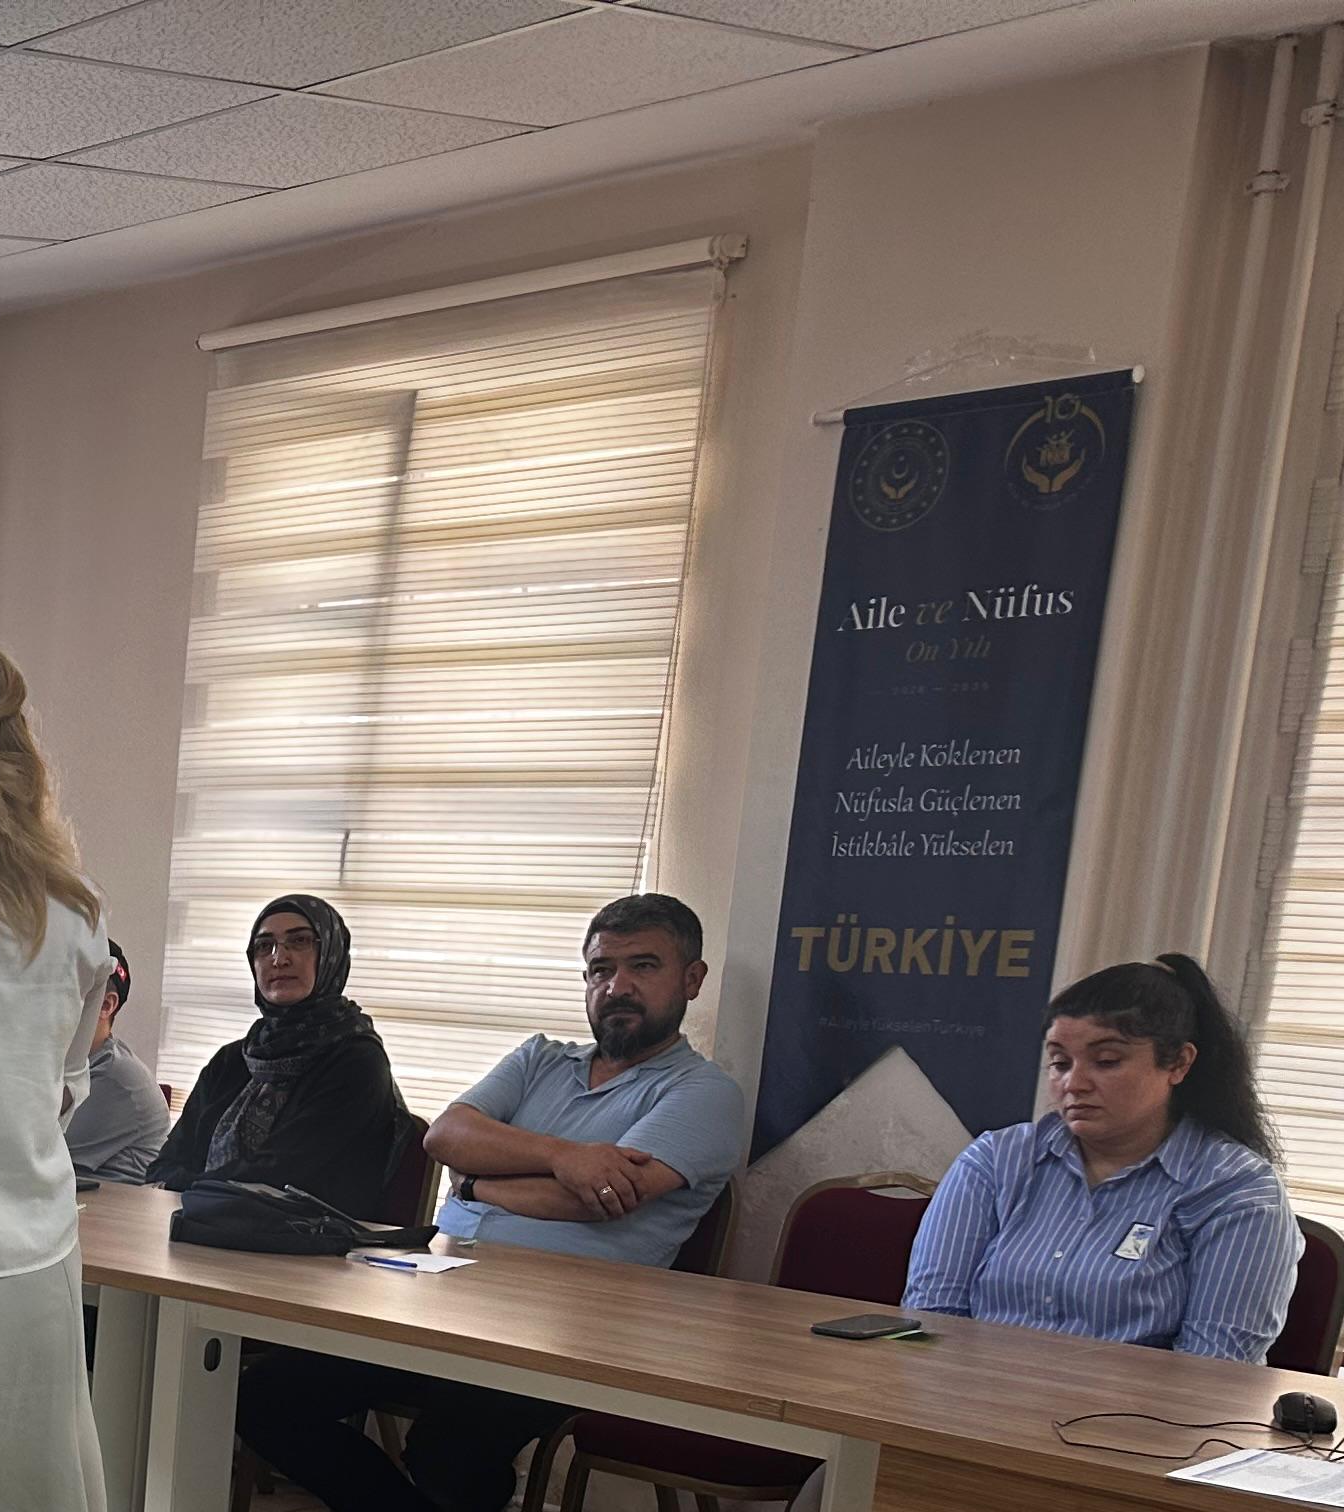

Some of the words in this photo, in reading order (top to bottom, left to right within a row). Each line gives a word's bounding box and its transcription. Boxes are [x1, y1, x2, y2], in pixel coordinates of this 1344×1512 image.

[836, 596, 905, 632] Aile
[915, 600, 953, 625] ve
[962, 583, 1075, 621] Nüfus
[905, 640, 939, 663] On
[846, 741, 914, 776] Aileyle
[920, 739, 1021, 767] Köklenen
[835, 786, 913, 821] Nüfusla
[920, 784, 1022, 816] Güçlenen
[920, 829, 1015, 857] Yükselen
[791, 913, 1035, 978] TÜRKİYE
